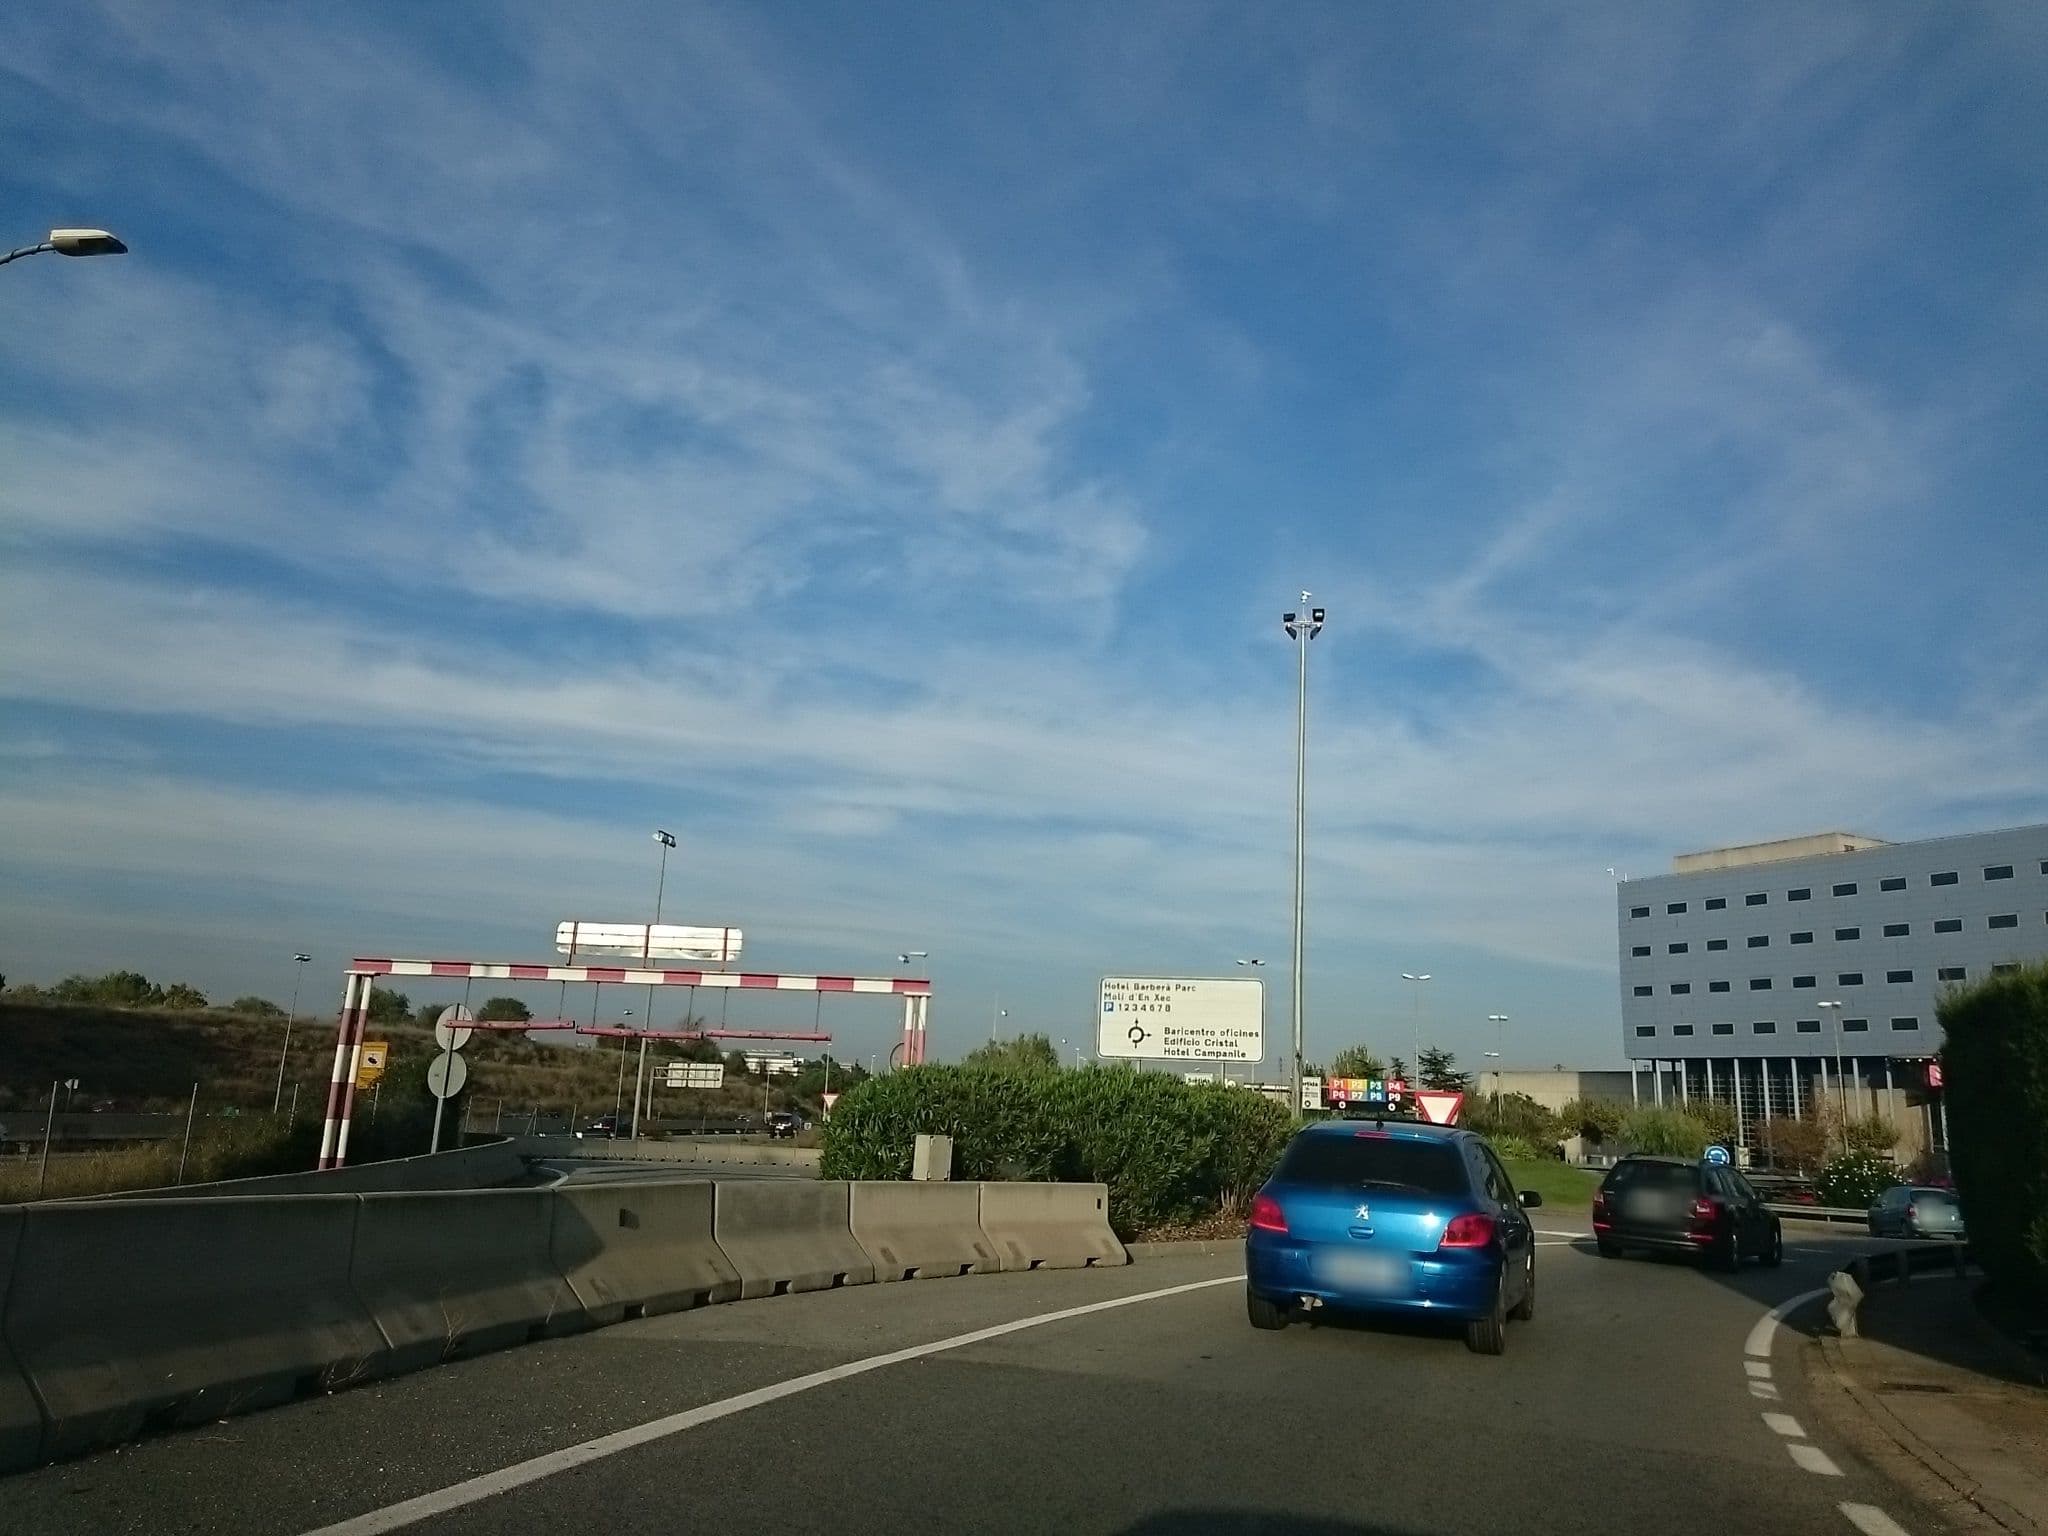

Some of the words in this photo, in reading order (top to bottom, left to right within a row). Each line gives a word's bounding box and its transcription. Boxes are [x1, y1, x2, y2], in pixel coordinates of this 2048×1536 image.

[1104, 982, 1129, 990] Hotel
[1164, 1027, 1216, 1036] Baricentro
[1220, 1029, 1259, 1037] oficines
[1164, 1037, 1200, 1046] Edificio
[1204, 1039, 1238, 1047] Cristal
[1164, 1048, 1190, 1056] Hotel
[1194, 1049, 1247, 1058] Campanile
[1333, 1080, 1344, 1088] P1
[1370, 1081, 1382, 1090] P3
[1388, 1083, 1400, 1091] P4
[1333, 1091, 1345, 1099] P6
[1388, 1093, 1401, 1101] P9
